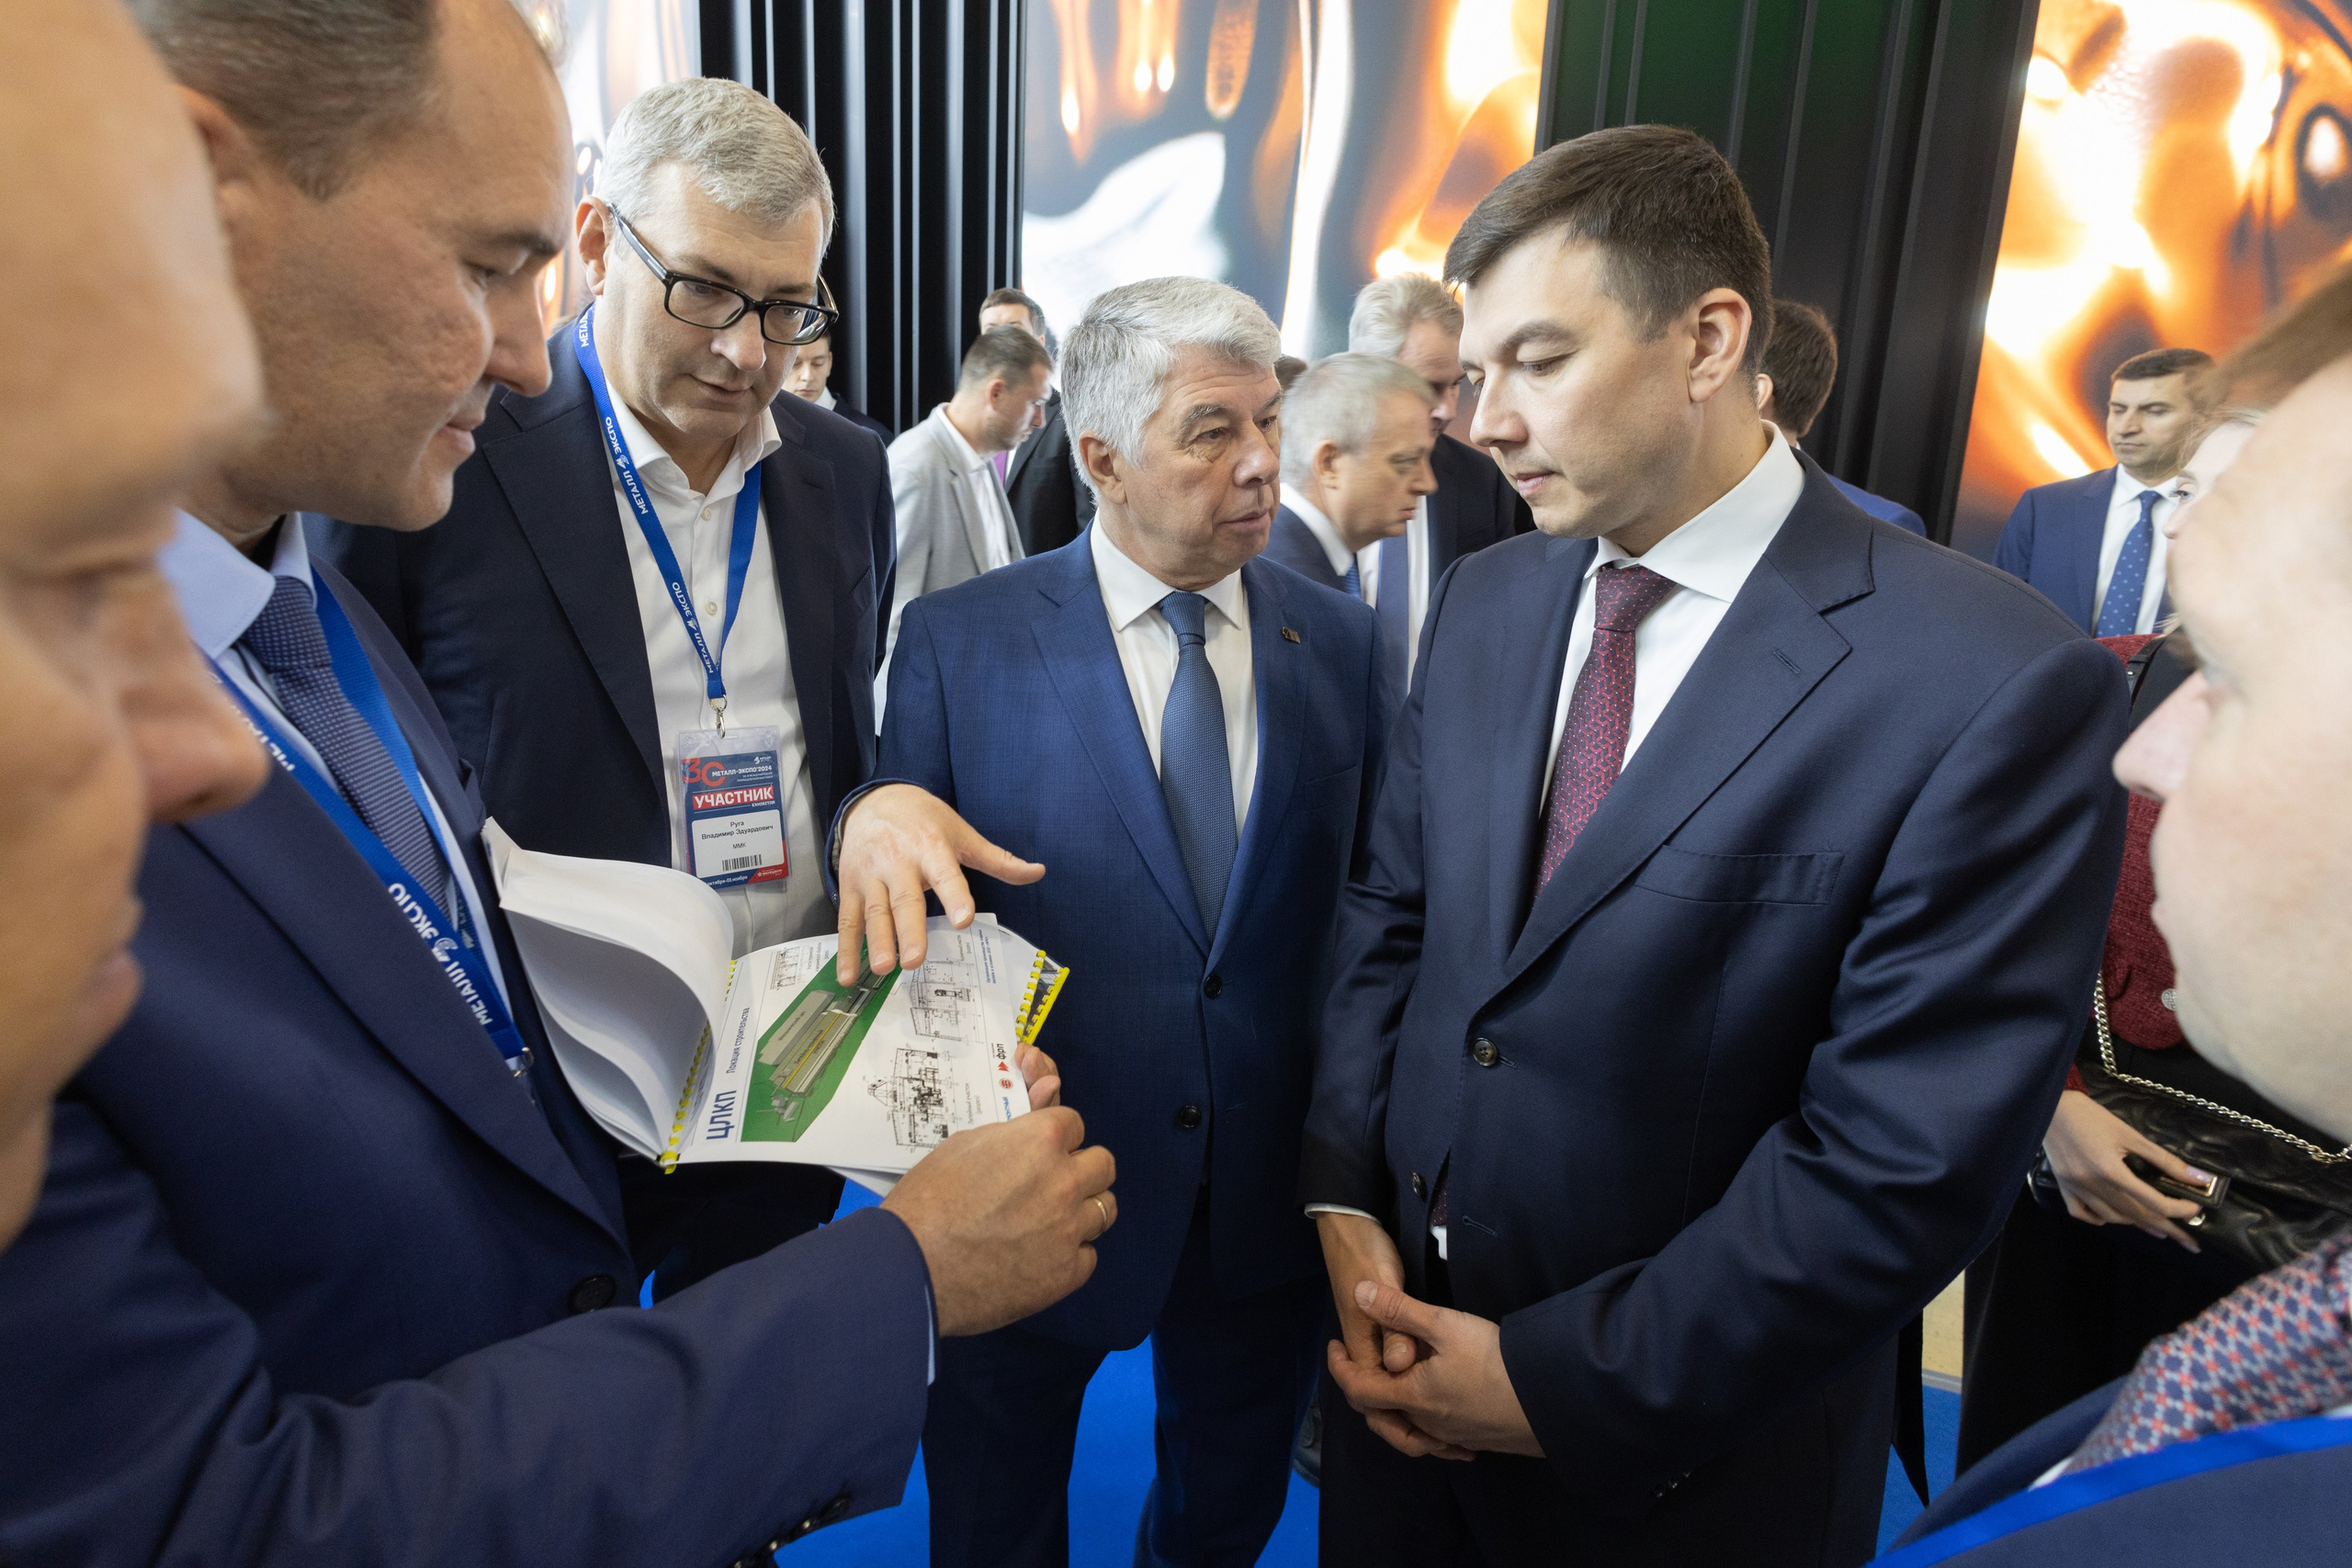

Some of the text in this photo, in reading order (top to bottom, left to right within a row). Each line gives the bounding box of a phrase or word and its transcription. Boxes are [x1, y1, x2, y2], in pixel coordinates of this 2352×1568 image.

[605, 416, 649, 514] МЕТАЛЛ ЭКСПО
[672, 581, 714, 673] МЕТАЛЛ ЭКСПО
[695, 787, 774, 808] УЧАСТНИК
[701, 826, 774, 840] Владимир Эдуардович
[726, 1007, 750, 1074] Локация строительства
[706, 1090, 737, 1140] ЦЛКП
